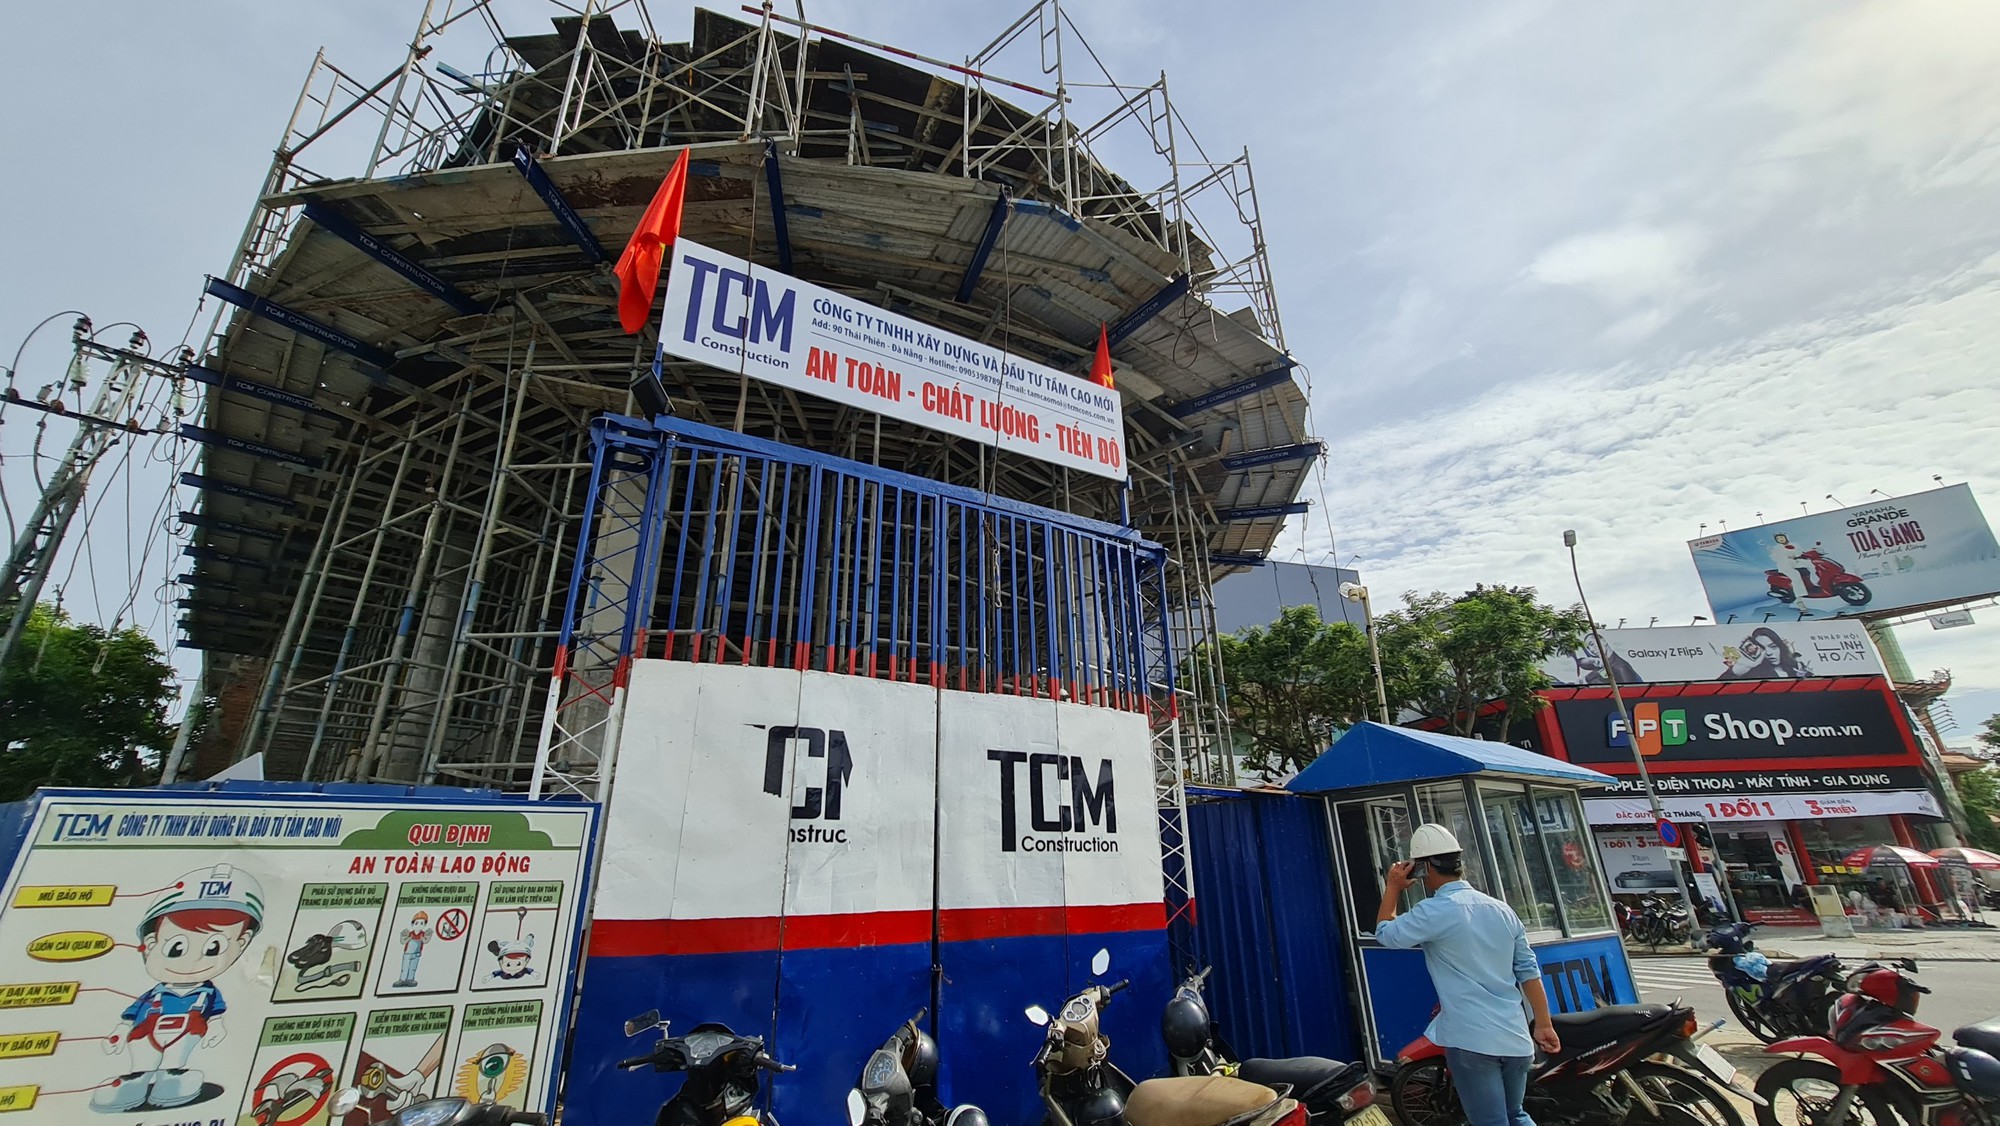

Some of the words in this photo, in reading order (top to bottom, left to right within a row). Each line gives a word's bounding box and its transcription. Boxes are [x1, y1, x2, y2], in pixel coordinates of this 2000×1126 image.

[360, 235, 378, 251] TCM
[380, 249, 445, 292] CONSTRUCTION
[683, 255, 796, 354] TCM
[264, 305, 285, 319] TCM
[288, 316, 357, 350] CONSTRUCTION
[701, 336, 790, 370] Construction
[811, 317, 831, 331] Add:
[832, 324, 843, 335] 90
[844, 328, 862, 341] Thái
[863, 334, 886, 349] Phiên
[891, 343, 902, 354] Đà
[929, 356, 958, 373] Hotline:
[1006, 383, 1027, 395] Email:
[813, 298, 852, 323] CÔNG
[856, 311, 875, 330] TY
[876, 318, 914, 344] TNHH
[917, 333, 941, 352] XÂY
[943, 342, 980, 367] DỰNG
[983, 356, 999, 373] VÀ
[1001, 361, 1025, 382] ĐẦU
[1027, 371, 1044, 387] TƯ
[1070, 387, 1092, 405] CAO
[1093, 394, 1114, 413] MỚI
[236, 381, 254, 391] TCM
[257, 388, 322, 411] CONSTRUCTION
[1194, 399, 1207, 407] TCM
[1208, 382, 1257, 402] CONSTRUCTION
[805, 346, 838, 383] AN
[845, 357, 901, 403] TOÀN
[922, 381, 975, 424] CHẤT
[980, 399, 1040, 443] LƯỢNG
[1056, 421, 1093, 460] TIẾN
[1098, 437, 1121, 473] ĐỘ
[1846, 508, 1910, 528] GRANDE
[1852, 505, 1896, 517] YAMAHA
[1878, 520, 1926, 548] SÁNG
[1628, 649, 1668, 659] Galaxy
[1669, 648, 1677, 657] Z
[1677, 647, 1703, 659] Flip5
[1814, 640, 1864, 651] LINH
[1657, 776, 1688, 793] ĐIỆN
[1691, 778, 1735, 792] THOẠI
[1745, 774, 1774, 789] MÁY
[1776, 773, 1811, 788] TÍNH
[1822, 776, 1848, 787] GIA
[1850, 774, 1891, 788] DỤNG
[987, 749, 1117, 852] TCM
[1705, 803, 1717, 817] 1
[1720, 798, 1761, 817] ĐỔI
[1761, 802, 1775, 816] 1
[1805, 800, 1824, 816] 3
[1823, 805, 1857, 815] TRIỆU
[52, 813, 114, 841] TCM
[408, 824, 442, 846] QUI
[445, 825, 492, 848] ĐỊNH
[1021, 836, 1119, 852] Construction
[348, 856, 376, 874] AN
[384, 852, 435, 874] TOÀN
[440, 856, 476, 874] LAO
[481, 852, 531, 876] ĐỘNG
[199, 881, 232, 899] TCM
[1542, 955, 1618, 1014] TCM
